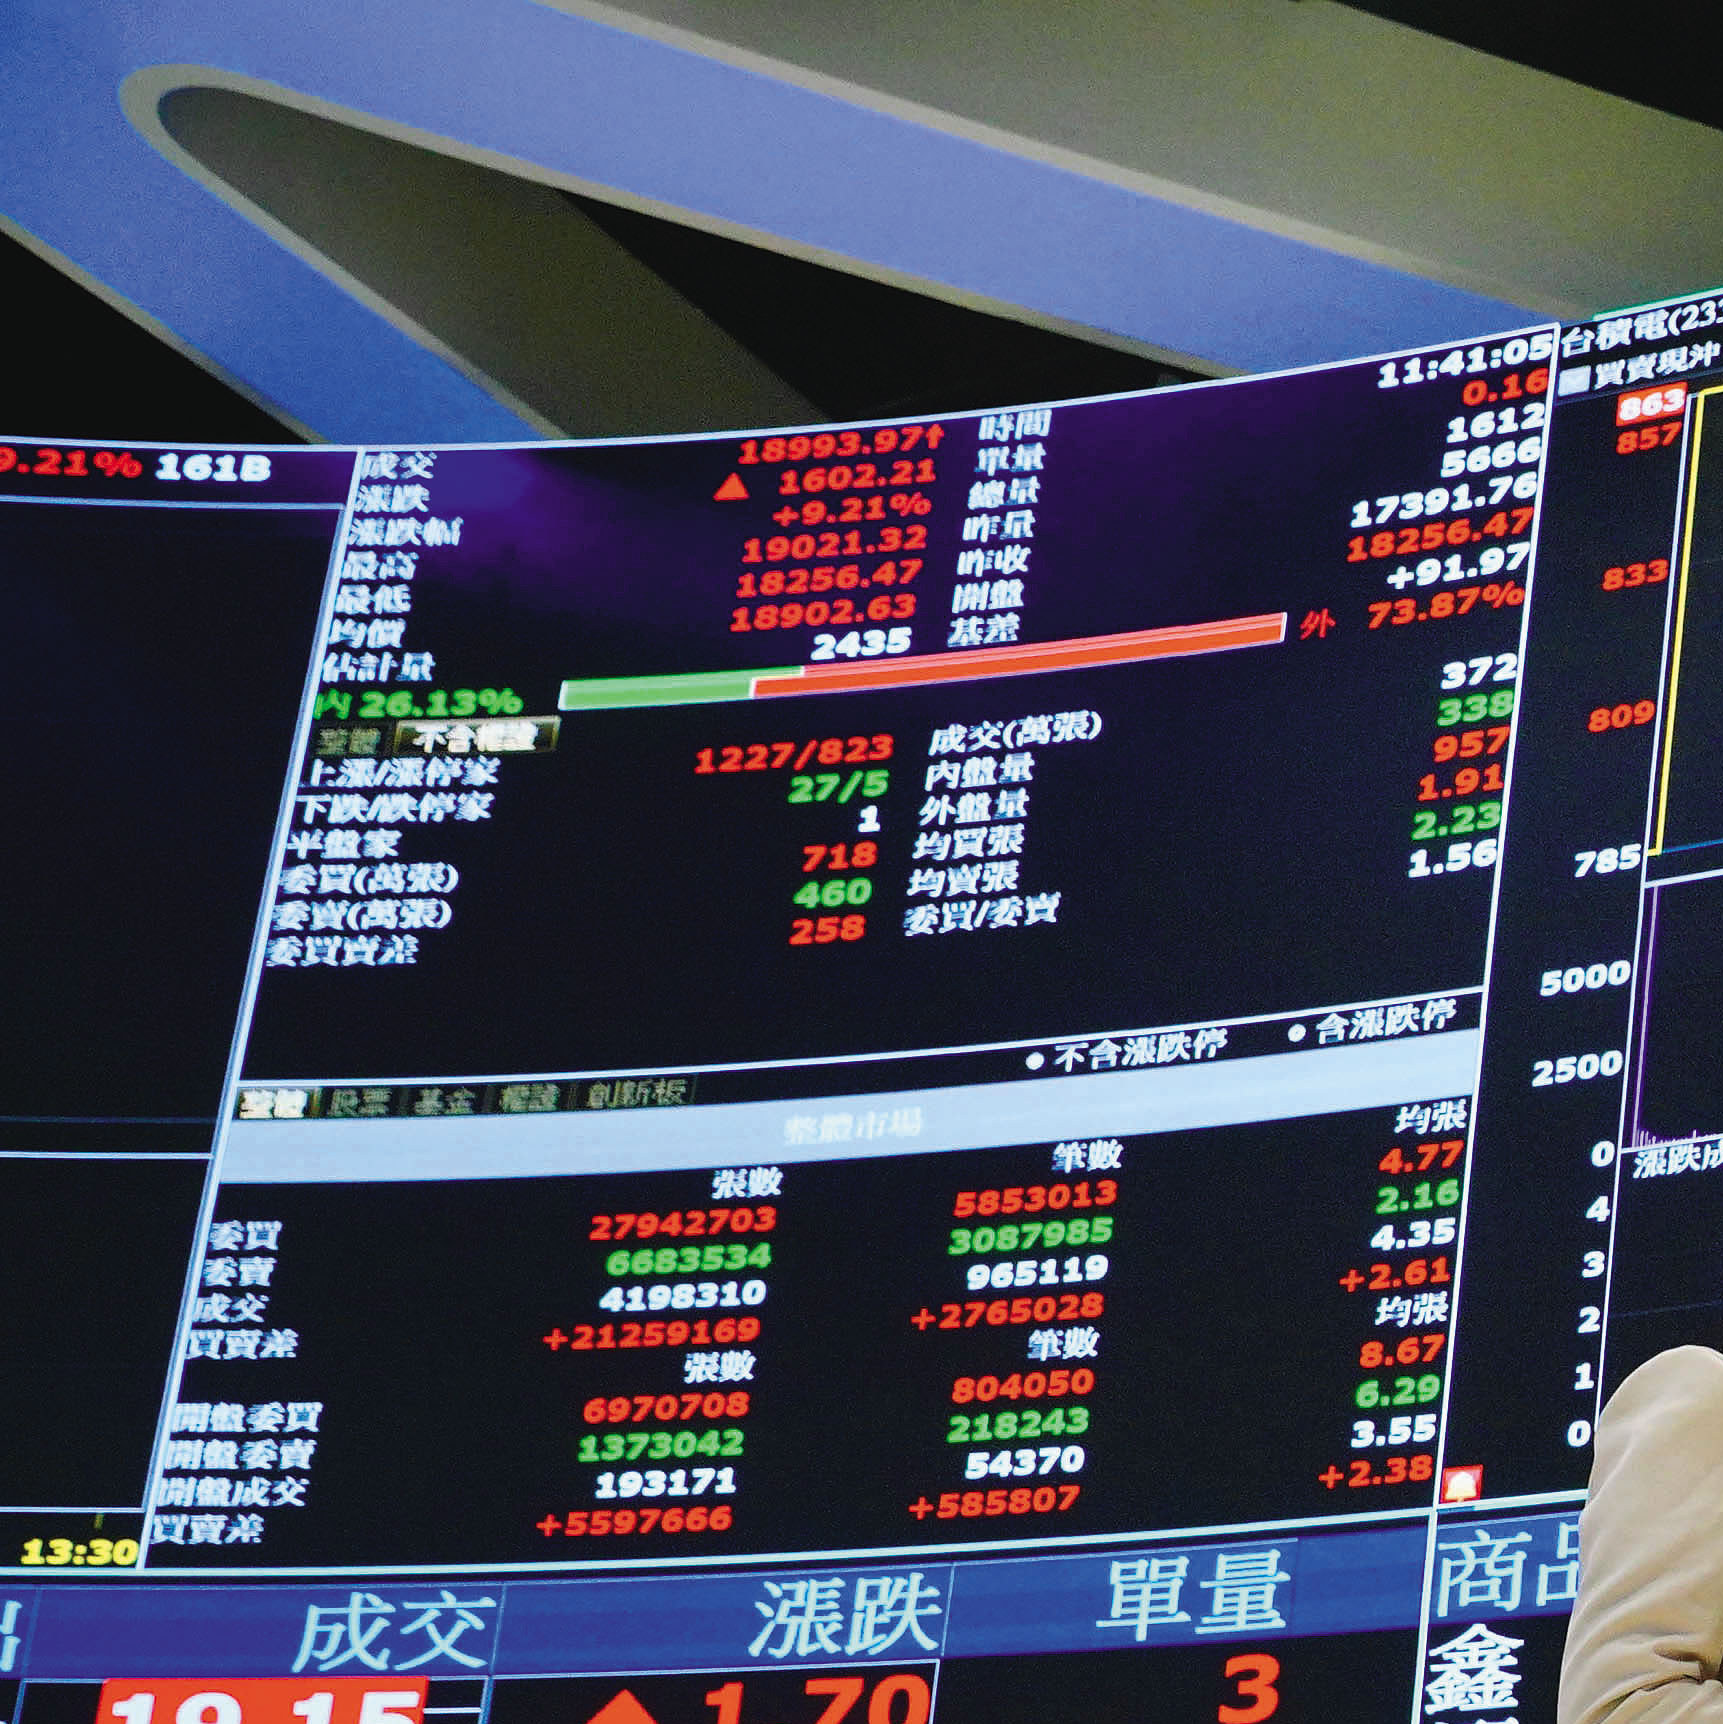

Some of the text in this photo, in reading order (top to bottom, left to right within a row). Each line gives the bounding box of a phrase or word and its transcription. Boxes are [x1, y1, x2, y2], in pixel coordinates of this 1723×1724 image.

[1378, 335, 1555, 388] 11:41:05
[1463, 368, 1548, 406] 0.16
[1619, 389, 1687, 420] 863
[1447, 399, 1549, 443] 1612
[1616, 422, 1682, 454] 857
[1441, 435, 1545, 477] 5666
[780, 458, 936, 494] 1602.21
[773, 492, 931, 526] +9.21%
[1352, 471, 1542, 527] 17391.76
[742, 525, 926, 562] 19021.32
[1348, 507, 1534, 562] 18256.47
[736, 559, 922, 598] 18256.47
[1387, 543, 1534, 589] +91.97
[1603, 559, 1668, 590] 833
[731, 594, 916, 632] 18902.63
[1368, 581, 1525, 628] 73.87%
[811, 627, 912, 660] 2435
[1442, 654, 1521, 689] 372
[359, 688, 523, 718] 26.13%
[1437, 690, 1515, 726] 338
[1588, 700, 1655, 732] 809
[695, 734, 893, 773] 1227/823
[1434, 726, 1510, 762] 957
[788, 770, 889, 803] 27/5
[1418, 764, 1504, 800] 1.91
[1411, 801, 1502, 840] 2.23
[803, 841, 877, 872] 718
[1409, 840, 1500, 877] 1.56
[1575, 844, 1643, 877] 785
[794, 878, 872, 908] 460
[789, 915, 866, 944] 258
[1540, 956, 1635, 996] 5000
[1532, 1050, 1623, 1087] 2500
[1379, 1140, 1464, 1174] 4.77
[954, 1180, 1117, 1217] 5853013
[590, 1206, 776, 1240] 27942703
[948, 1217, 1113, 1255] 3087985
[1371, 1217, 1455, 1250] 4.35
[606, 1243, 771, 1276] 6683534
[968, 1255, 1108, 1290] 965119
[1340, 1257, 1450, 1292] +2.61
[600, 1280, 766, 1311] 4198310
[912, 1292, 1104, 1330] +2765028
[544, 1317, 760, 1350] +21259169
[1360, 1334, 1445, 1368] 8.67
[952, 1368, 1094, 1403] 804050
[1356, 1374, 1440, 1408] 6.29
[584, 1392, 750, 1424] 6970708
[947, 1407, 1089, 1443] 218243
[578, 1429, 744, 1462] 1373042
[1351, 1414, 1436, 1447] 3.55
[965, 1446, 1084, 1479] 54370
[1319, 1455, 1432, 1488] +2.38
[596, 1467, 736, 1498] 193171
[909, 1486, 1080, 1520] +585807
[536, 1506, 732, 1536] +5597666
[21, 1539, 138, 1564] 13:30
[1096, 1549, 1290, 1641] 單量
[292, 1590, 496, 1672] 成交
[748, 1569, 954, 1658] 漲跌
[1219, 1654, 1280, 1724] 3
